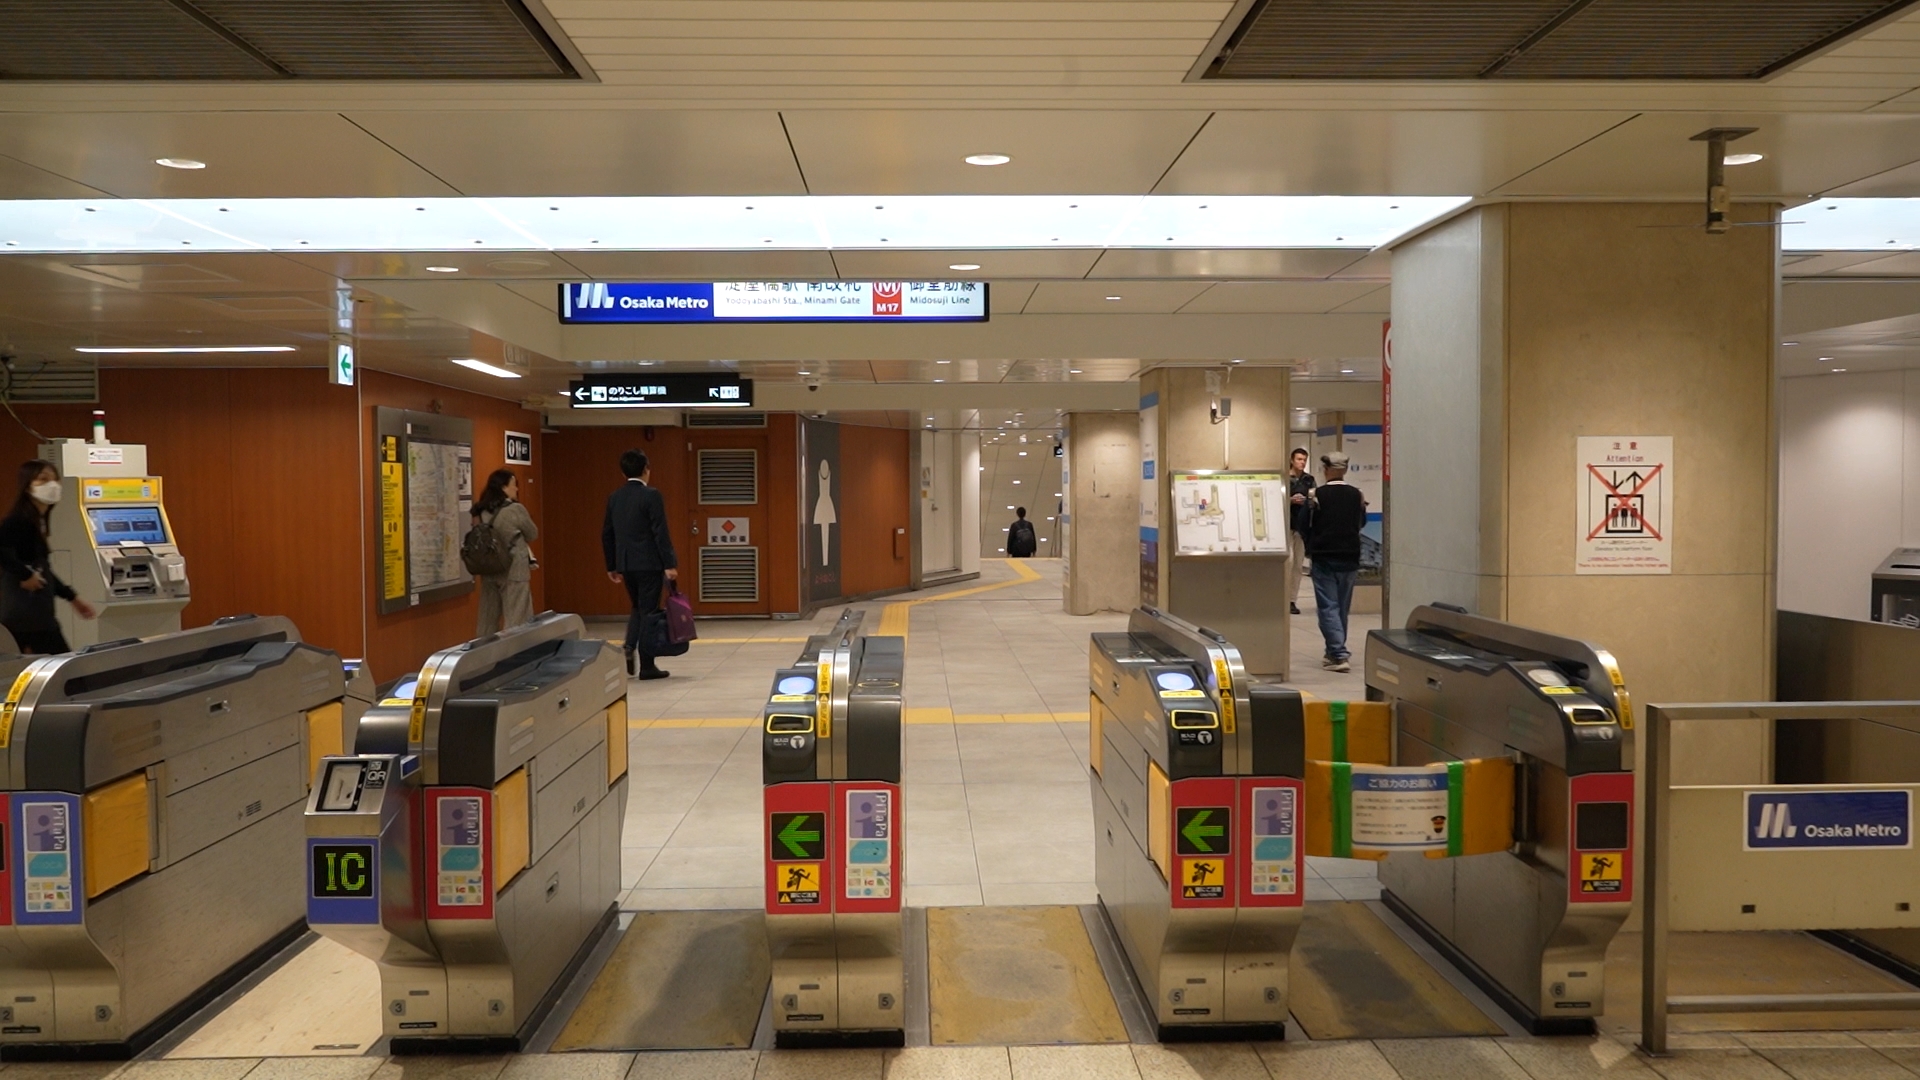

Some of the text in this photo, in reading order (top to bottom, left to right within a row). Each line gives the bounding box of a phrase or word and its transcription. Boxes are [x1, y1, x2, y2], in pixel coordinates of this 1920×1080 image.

[619, 296, 709, 309] Osaka Metro
[725, 297, 781, 306] Yodoyabashi
[804, 296, 838, 305] Minami
[840, 296, 861, 305] Gate
[909, 296, 971, 306] Midosuji Line
[876, 303, 899, 313] M17
[1606, 454, 1644, 463] Attention
[367, 770, 387, 781] QR
[1367, 778, 1437, 789] ご協力のお願い
[875, 794, 888, 837] PiTaPa
[1281, 792, 1293, 834] PiTaPa
[53, 807, 66, 850] PiTaPa
[467, 802, 479, 844] PiTaPa
[1804, 824, 1902, 838] Osaka Metro
[325, 852, 366, 891] IC
[1173, 991, 1181, 1001] 5
[1267, 990, 1275, 1001] 6
[1555, 985, 1563, 996] 6
[491, 1003, 499, 1012] 4
[787, 998, 794, 1008] 4
[881, 997, 889, 1007] 5
[98, 1008, 107, 1019] 3
[395, 1003, 403, 1013] 3
[2, 1010, 11, 1020] 2
